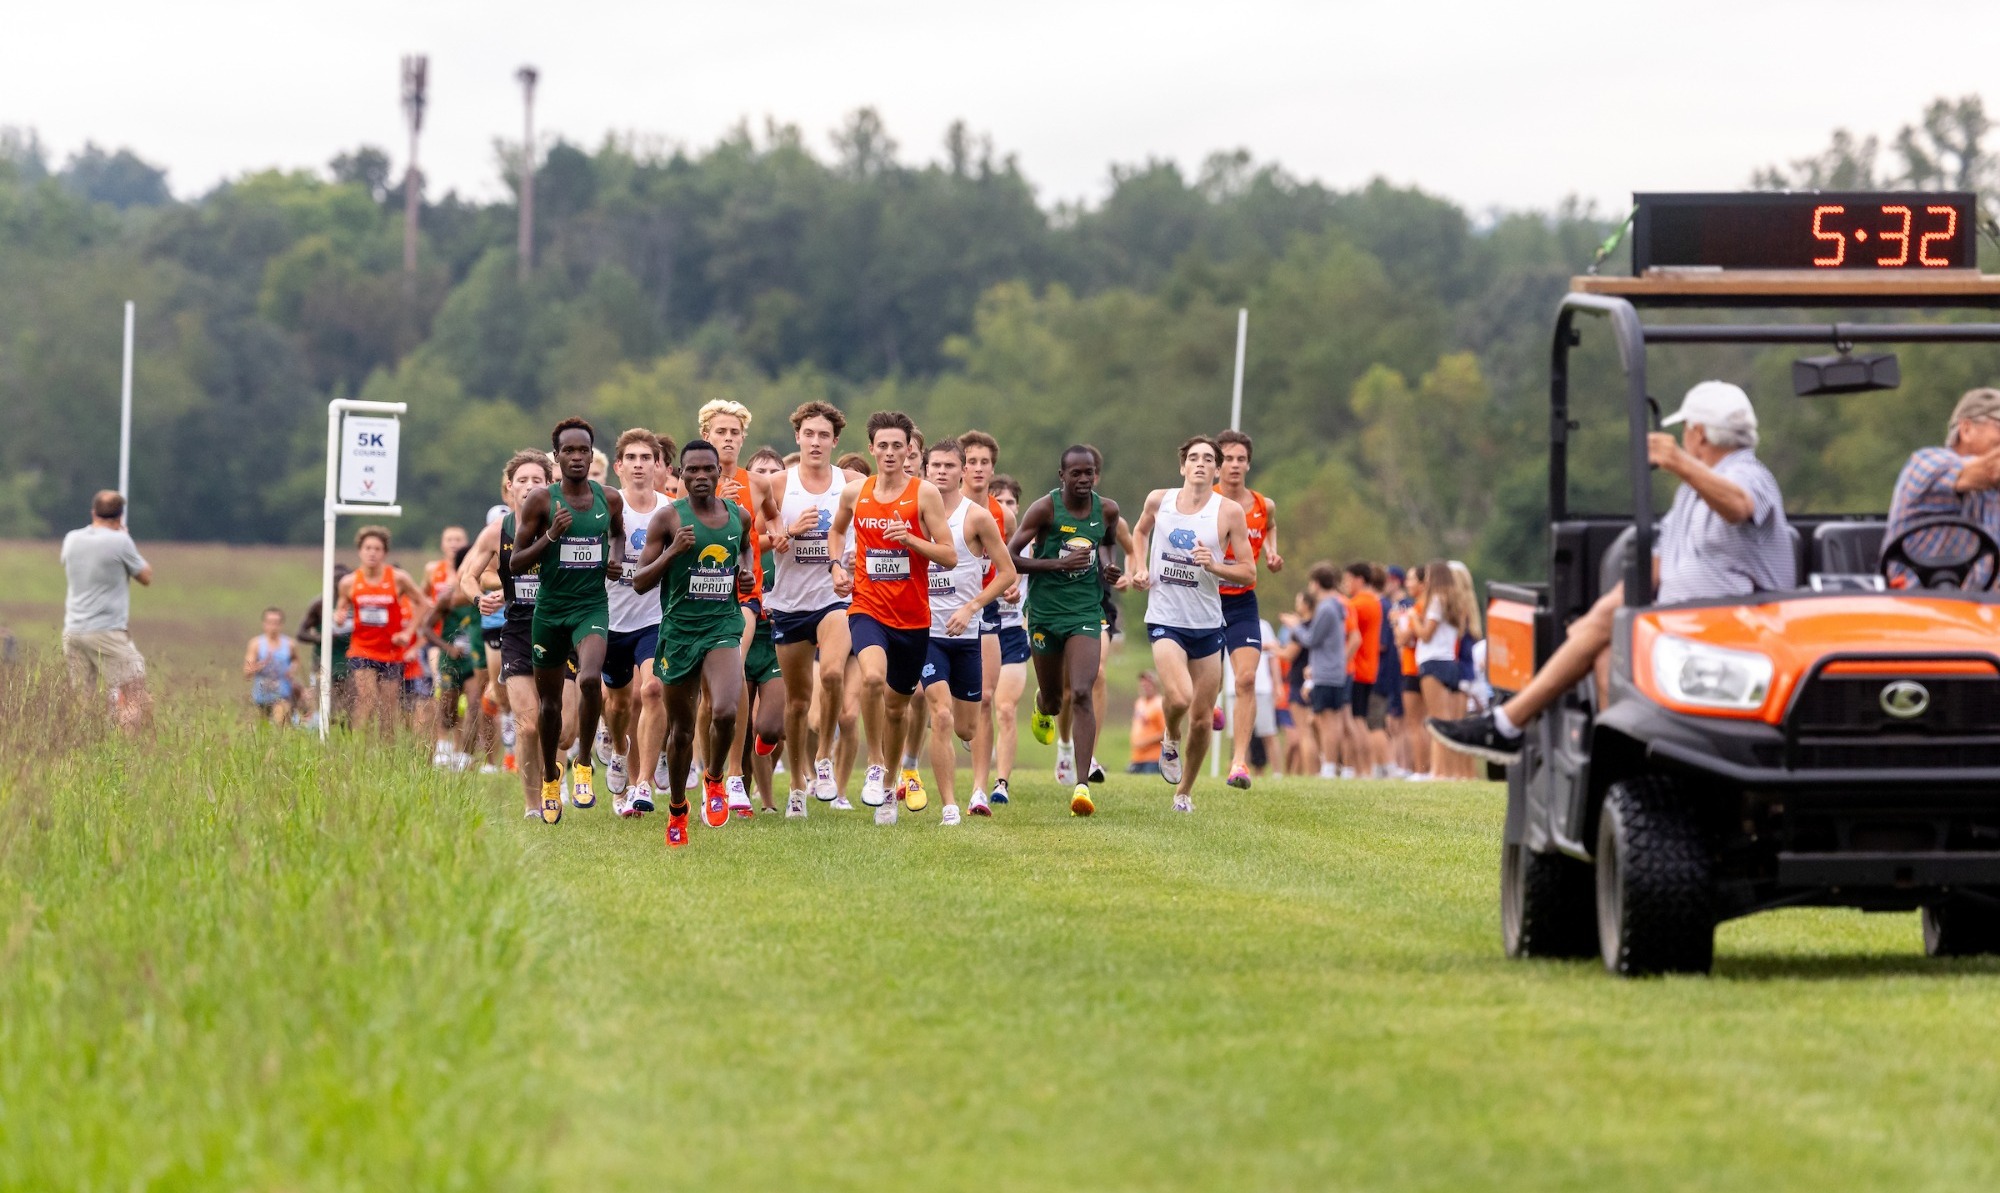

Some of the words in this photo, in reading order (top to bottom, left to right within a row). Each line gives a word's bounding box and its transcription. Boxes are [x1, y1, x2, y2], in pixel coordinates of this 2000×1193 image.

[358, 432, 383, 447] 5K
[858, 518, 912, 530] VIRGIA
[573, 551, 591, 560] TOO
[796, 546, 829, 555] BARRE
[875, 563, 900, 573] GRAY
[1163, 566, 1195, 580] BURNS
[691, 583, 732, 593] KIPRUTO
